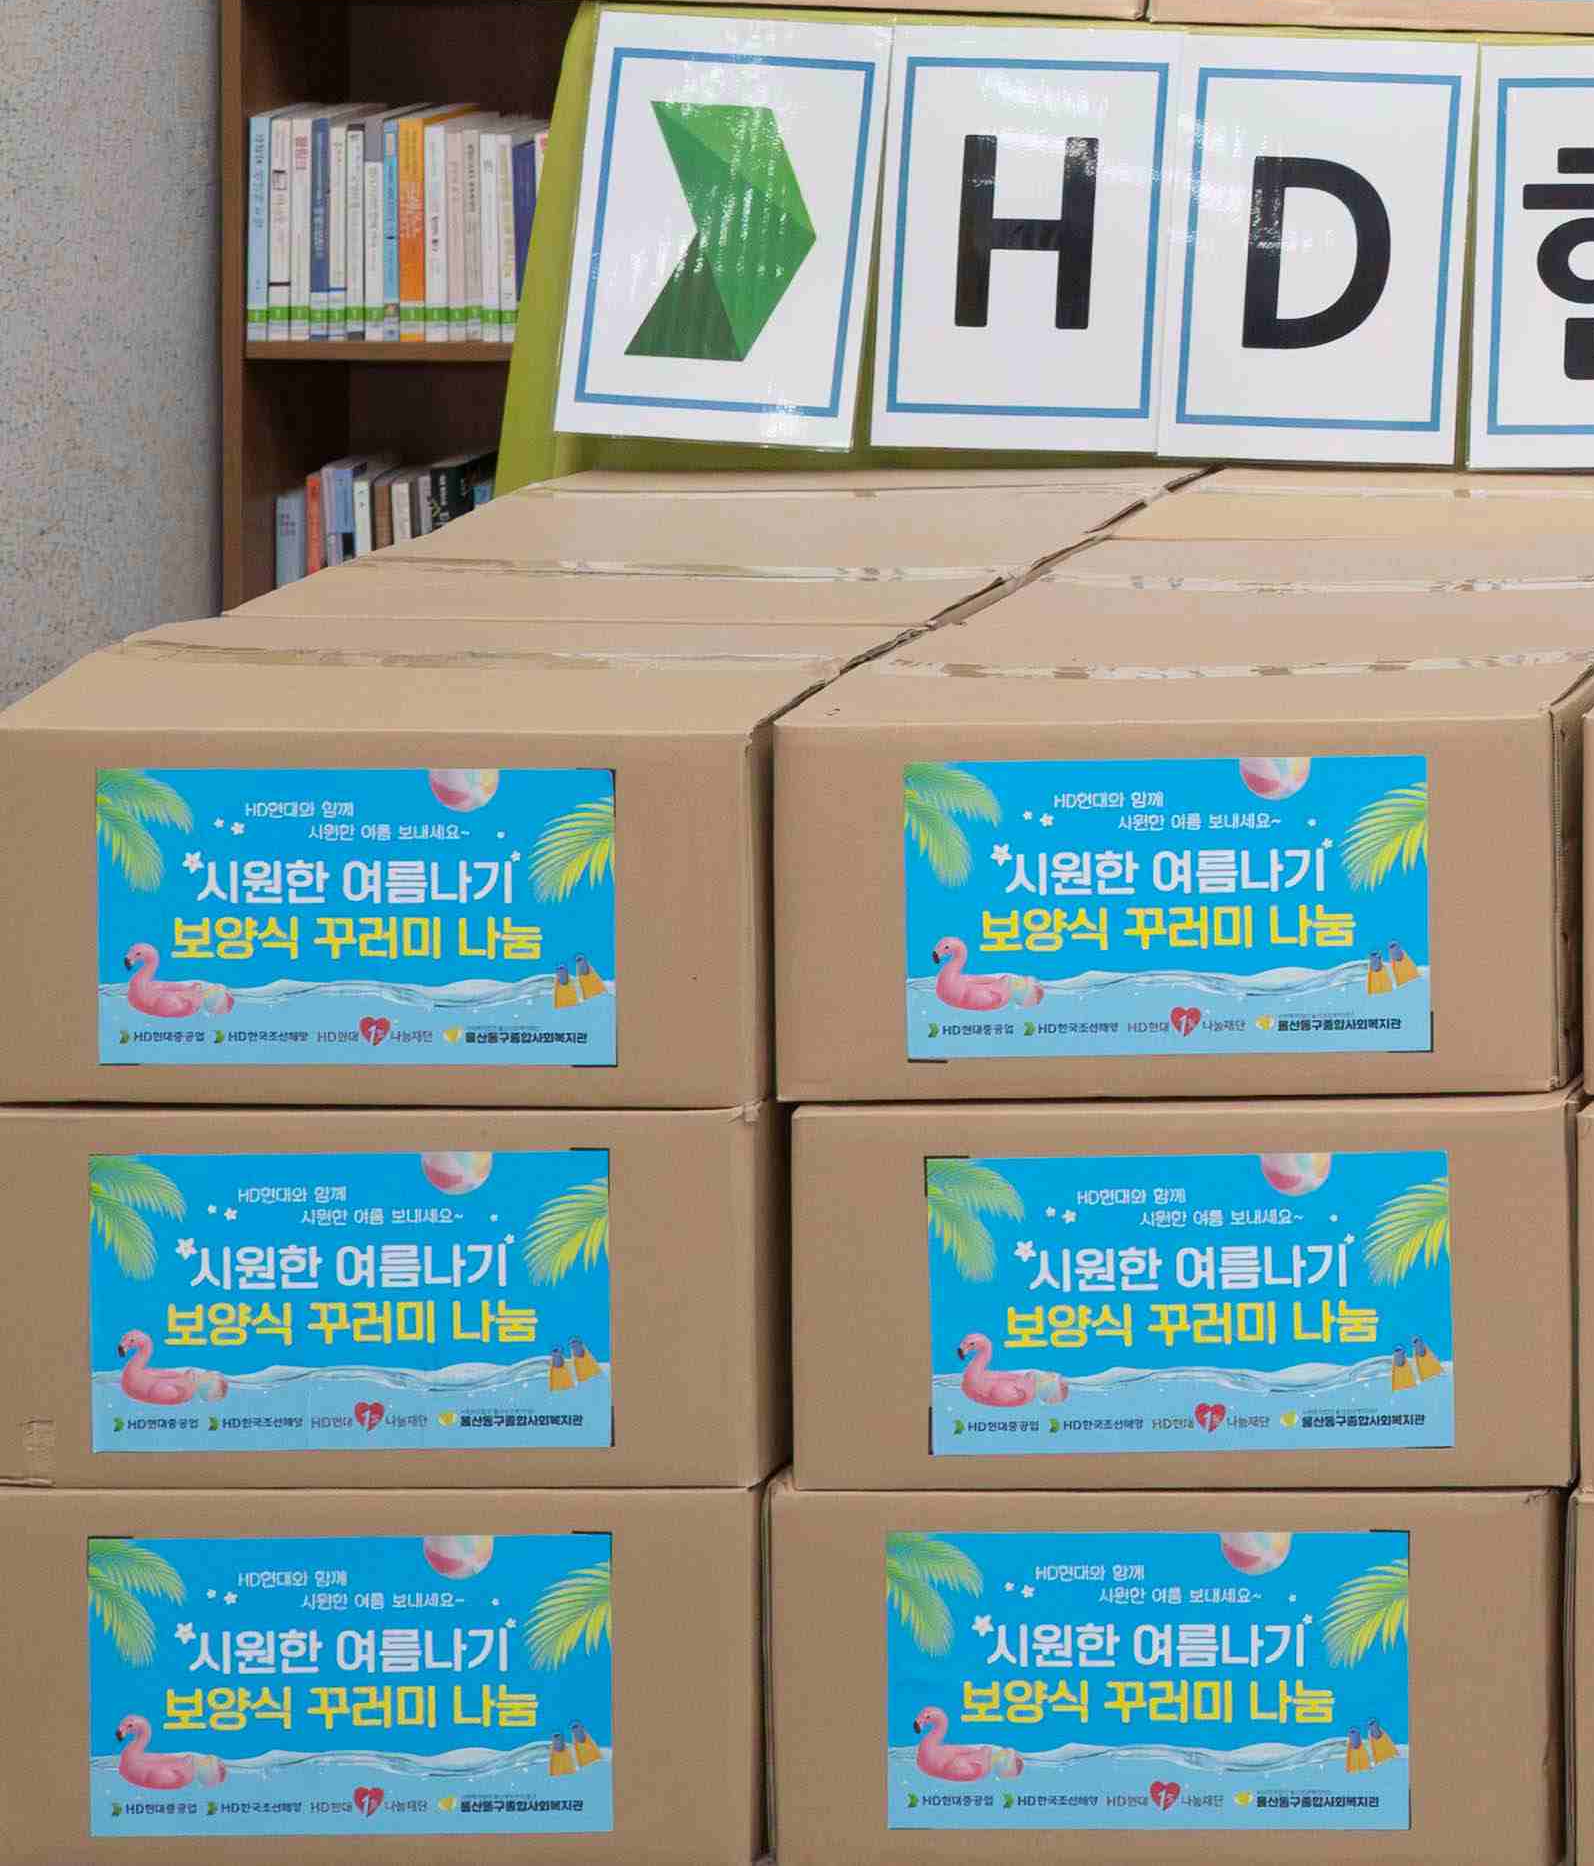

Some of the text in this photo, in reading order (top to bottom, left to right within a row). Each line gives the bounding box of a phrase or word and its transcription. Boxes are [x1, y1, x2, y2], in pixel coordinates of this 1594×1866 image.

[1004, 846, 1325, 898] 시원한 여름나기
[979, 903, 1357, 954] 보양식 꾸러미 나눔
